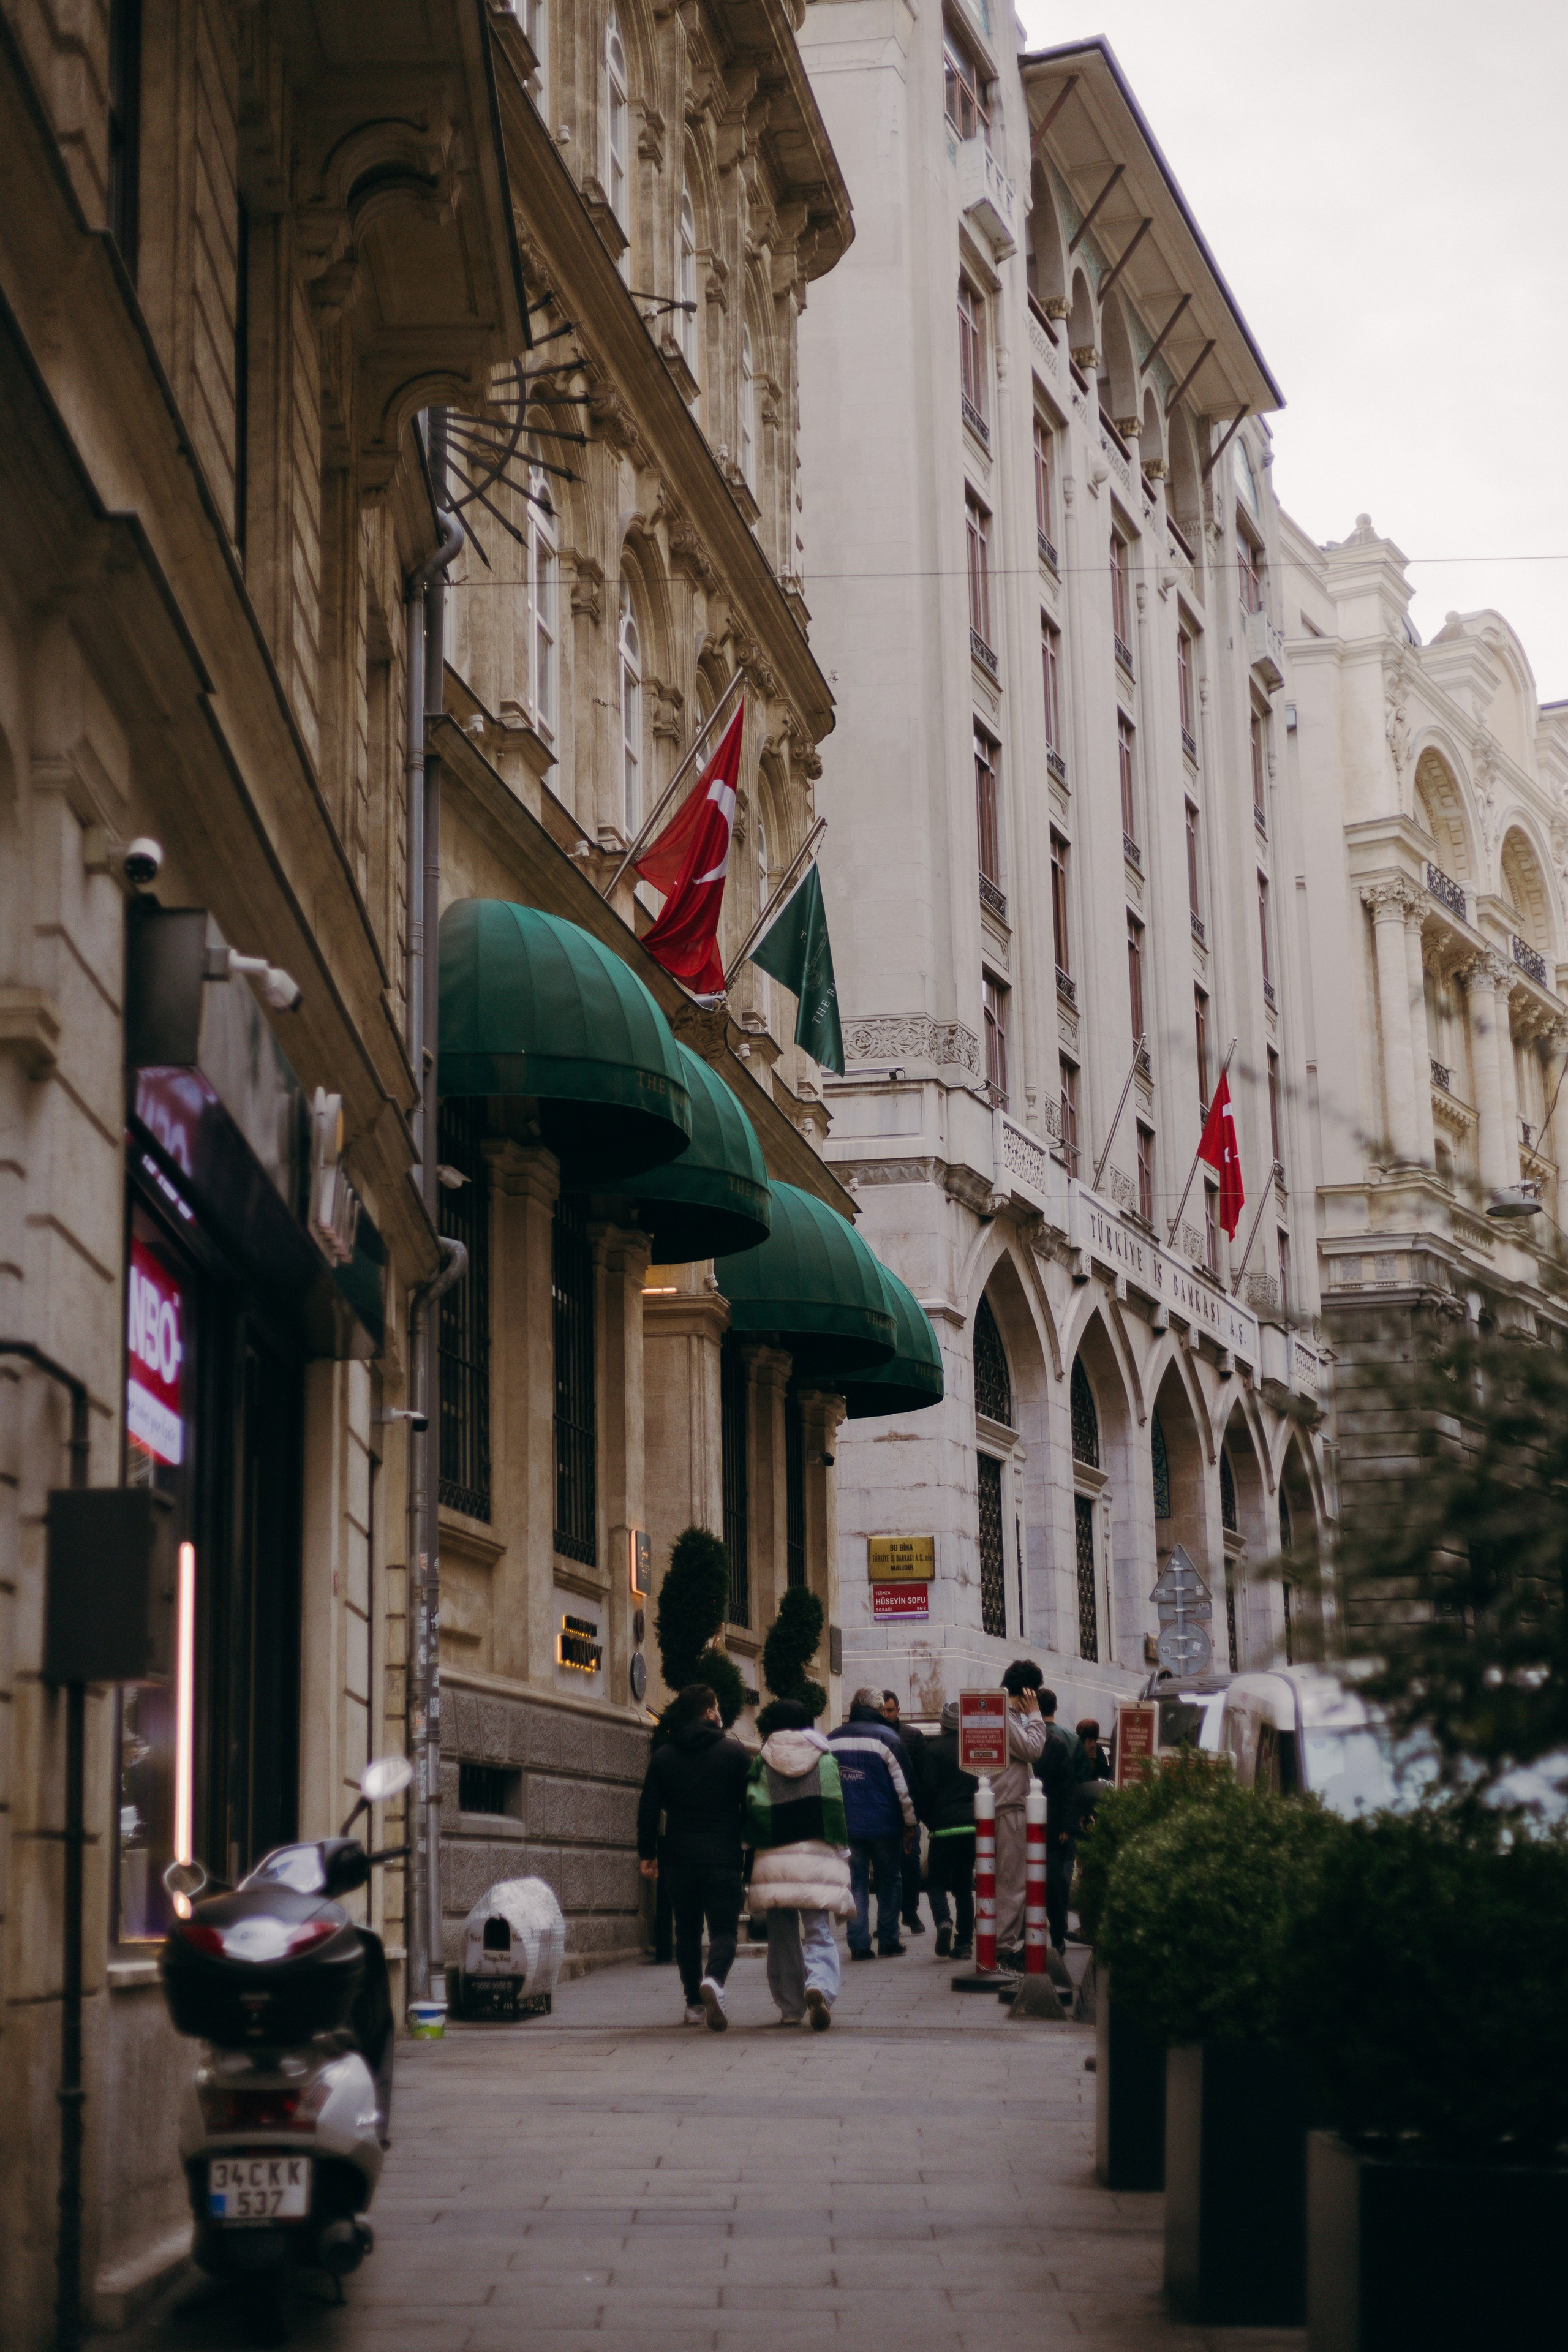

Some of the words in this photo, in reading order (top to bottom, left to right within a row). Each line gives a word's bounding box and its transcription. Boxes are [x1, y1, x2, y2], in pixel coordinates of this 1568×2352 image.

[812, 999, 831, 1025] THE
[636, 1070, 666, 1094] THE
[728, 1175, 752, 1197] THE
[1090, 1213, 1143, 1272] TÜRKİYE
[1153, 1254, 1163, 1288] İŞ
[1173, 1273, 1220, 1325] BANKASI
[1230, 1314, 1246, 1345] A.Ş.
[873, 1553, 889, 1563] TÜRKİYE
[891, 1553, 895, 1564] İŞ
[896, 1553, 914, 1562] BANKASI
[899, 1542, 913, 1551] BİNA
[876, 1596, 906, 1605] HÜSEYİN
[559, 1635, 603, 1671] ONVOY
[238, 2190, 284, 2216] 537
